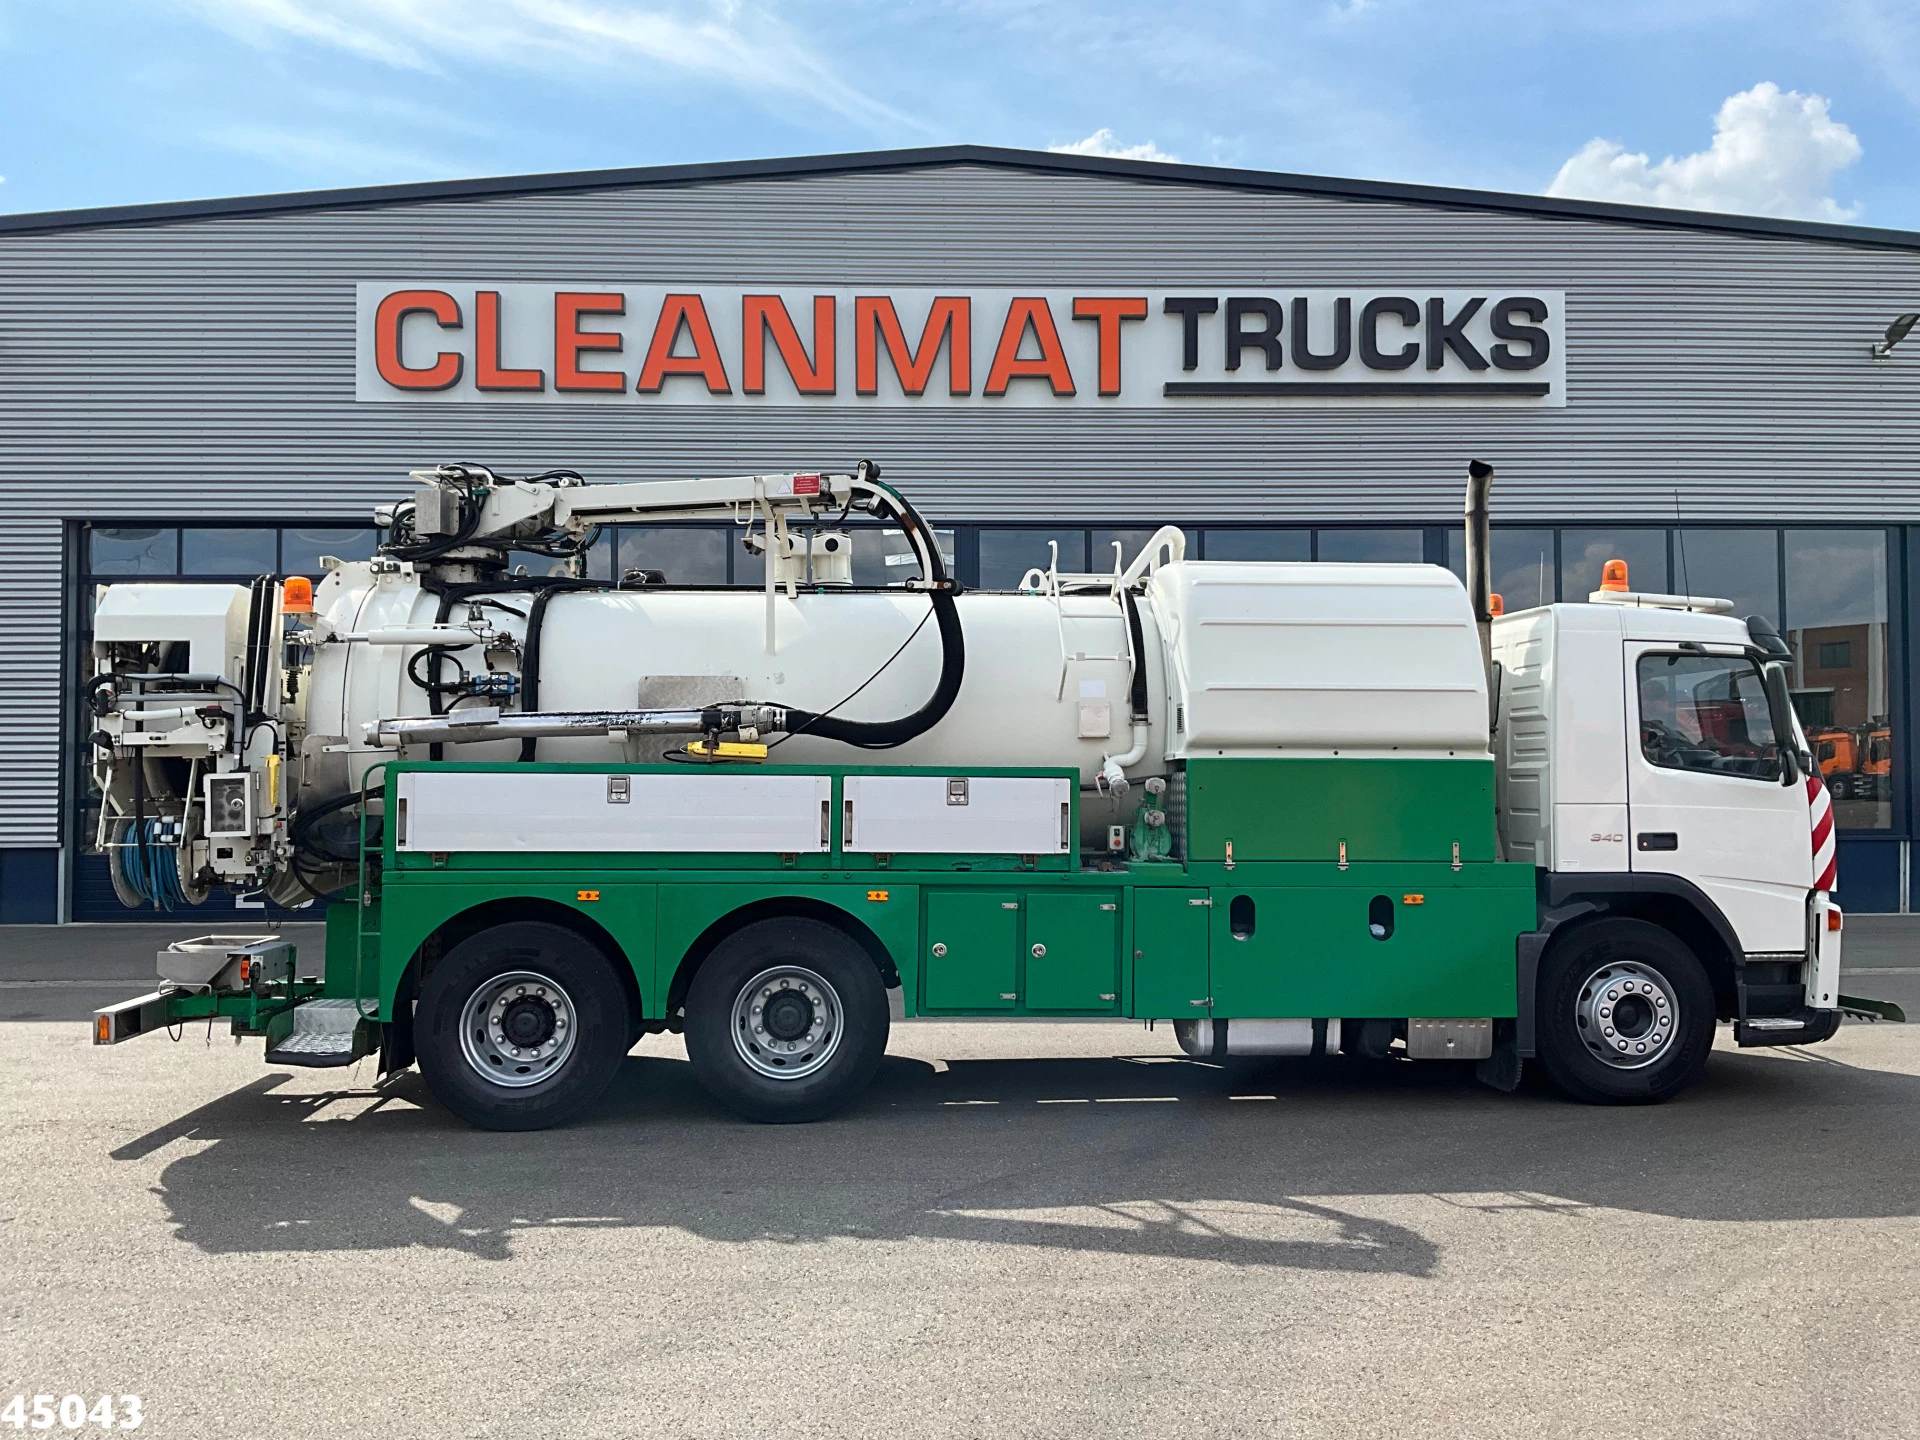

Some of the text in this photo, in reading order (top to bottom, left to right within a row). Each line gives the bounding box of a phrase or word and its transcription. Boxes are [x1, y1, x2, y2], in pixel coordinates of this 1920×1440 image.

[375, 290, 1550, 396] CLEANMAT TRUCKS
[1590, 833, 1624, 842] 340
